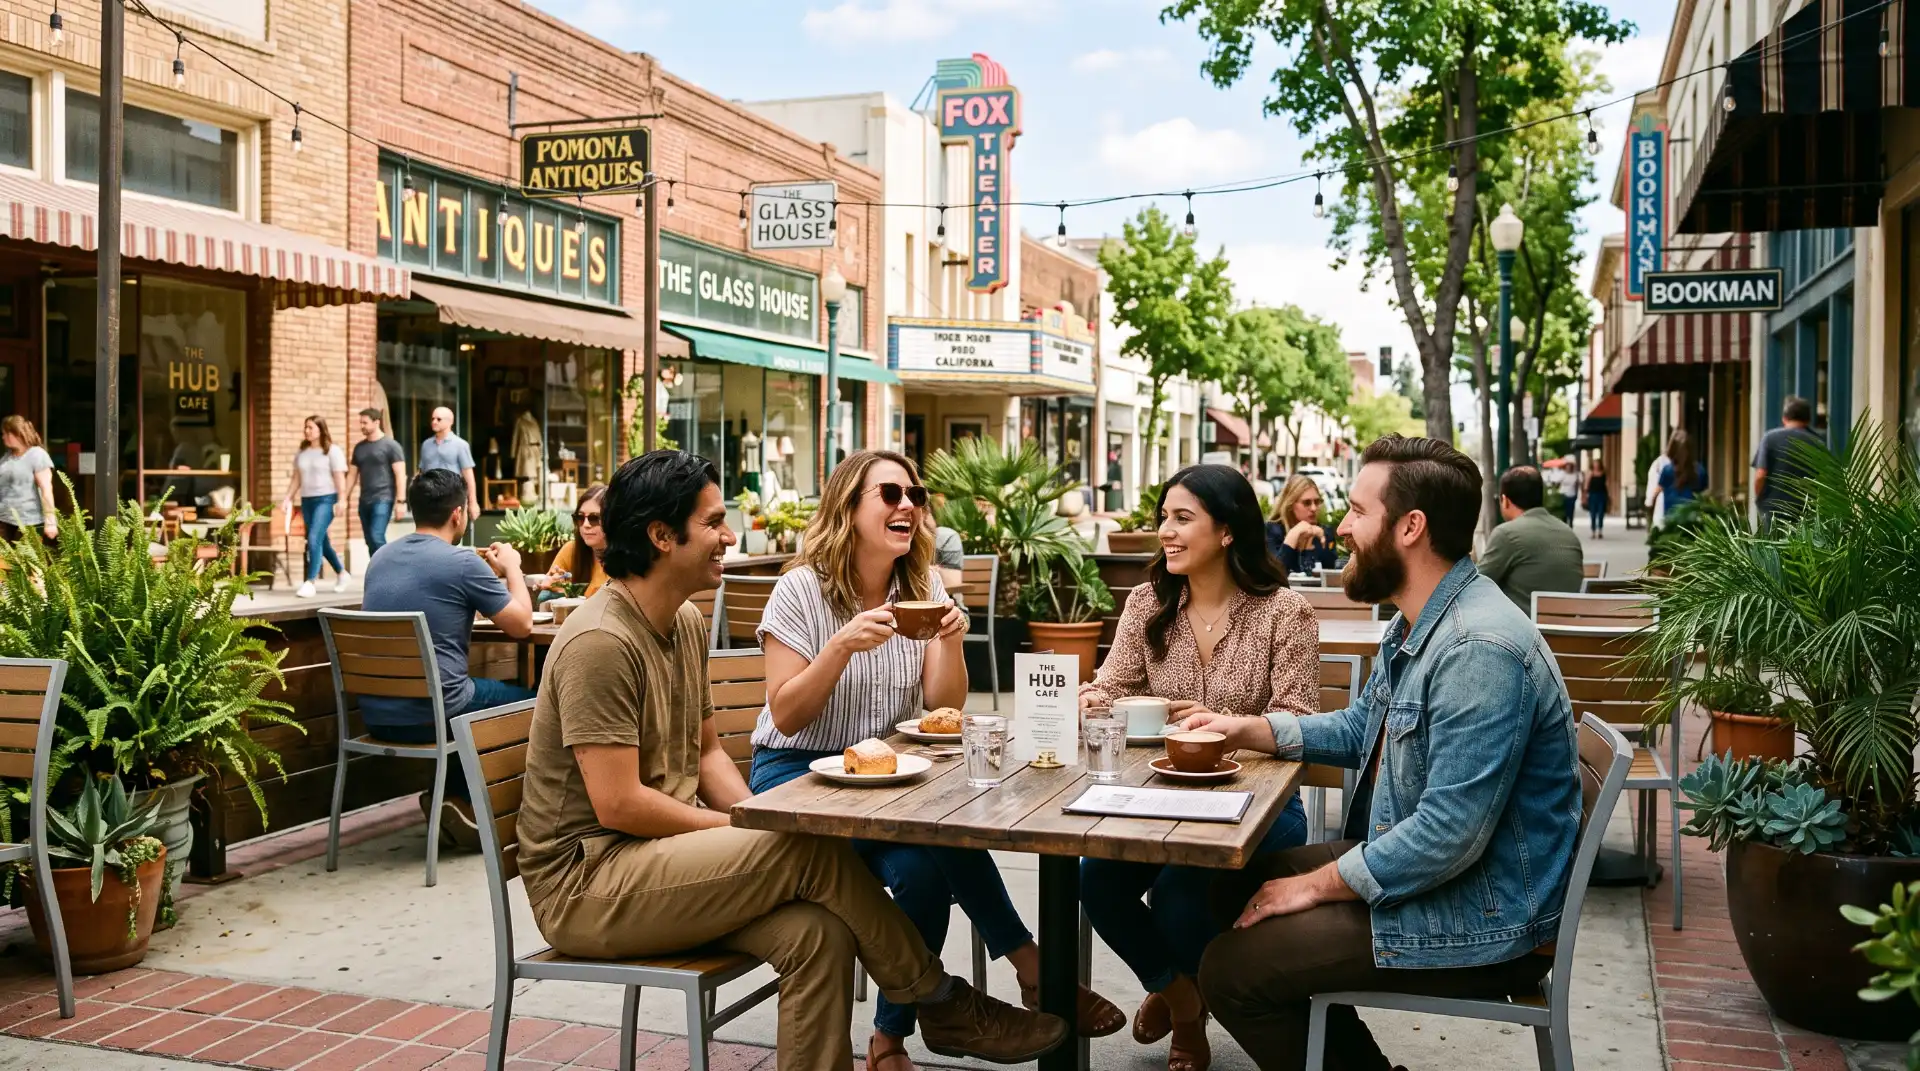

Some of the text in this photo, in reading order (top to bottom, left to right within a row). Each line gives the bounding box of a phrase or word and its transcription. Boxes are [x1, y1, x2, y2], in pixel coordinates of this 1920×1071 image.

[945, 95, 1010, 127] FOX
[536, 135, 634, 163] POMONA
[529, 161, 645, 190] ANTIQUES
[783, 190, 802, 199] THE
[977, 133, 998, 274] THEATER
[759, 201, 826, 220] GLASS
[758, 222, 826, 241] HOUSE
[658, 259, 809, 321] THE GLASS HOUSE
[1651, 279, 1774, 304] BOOKMAN
[185, 347, 204, 360] THE
[169, 361, 220, 392] HUB
[179, 396, 208, 410] CAFE
[1029, 673, 1066, 688] HUB
